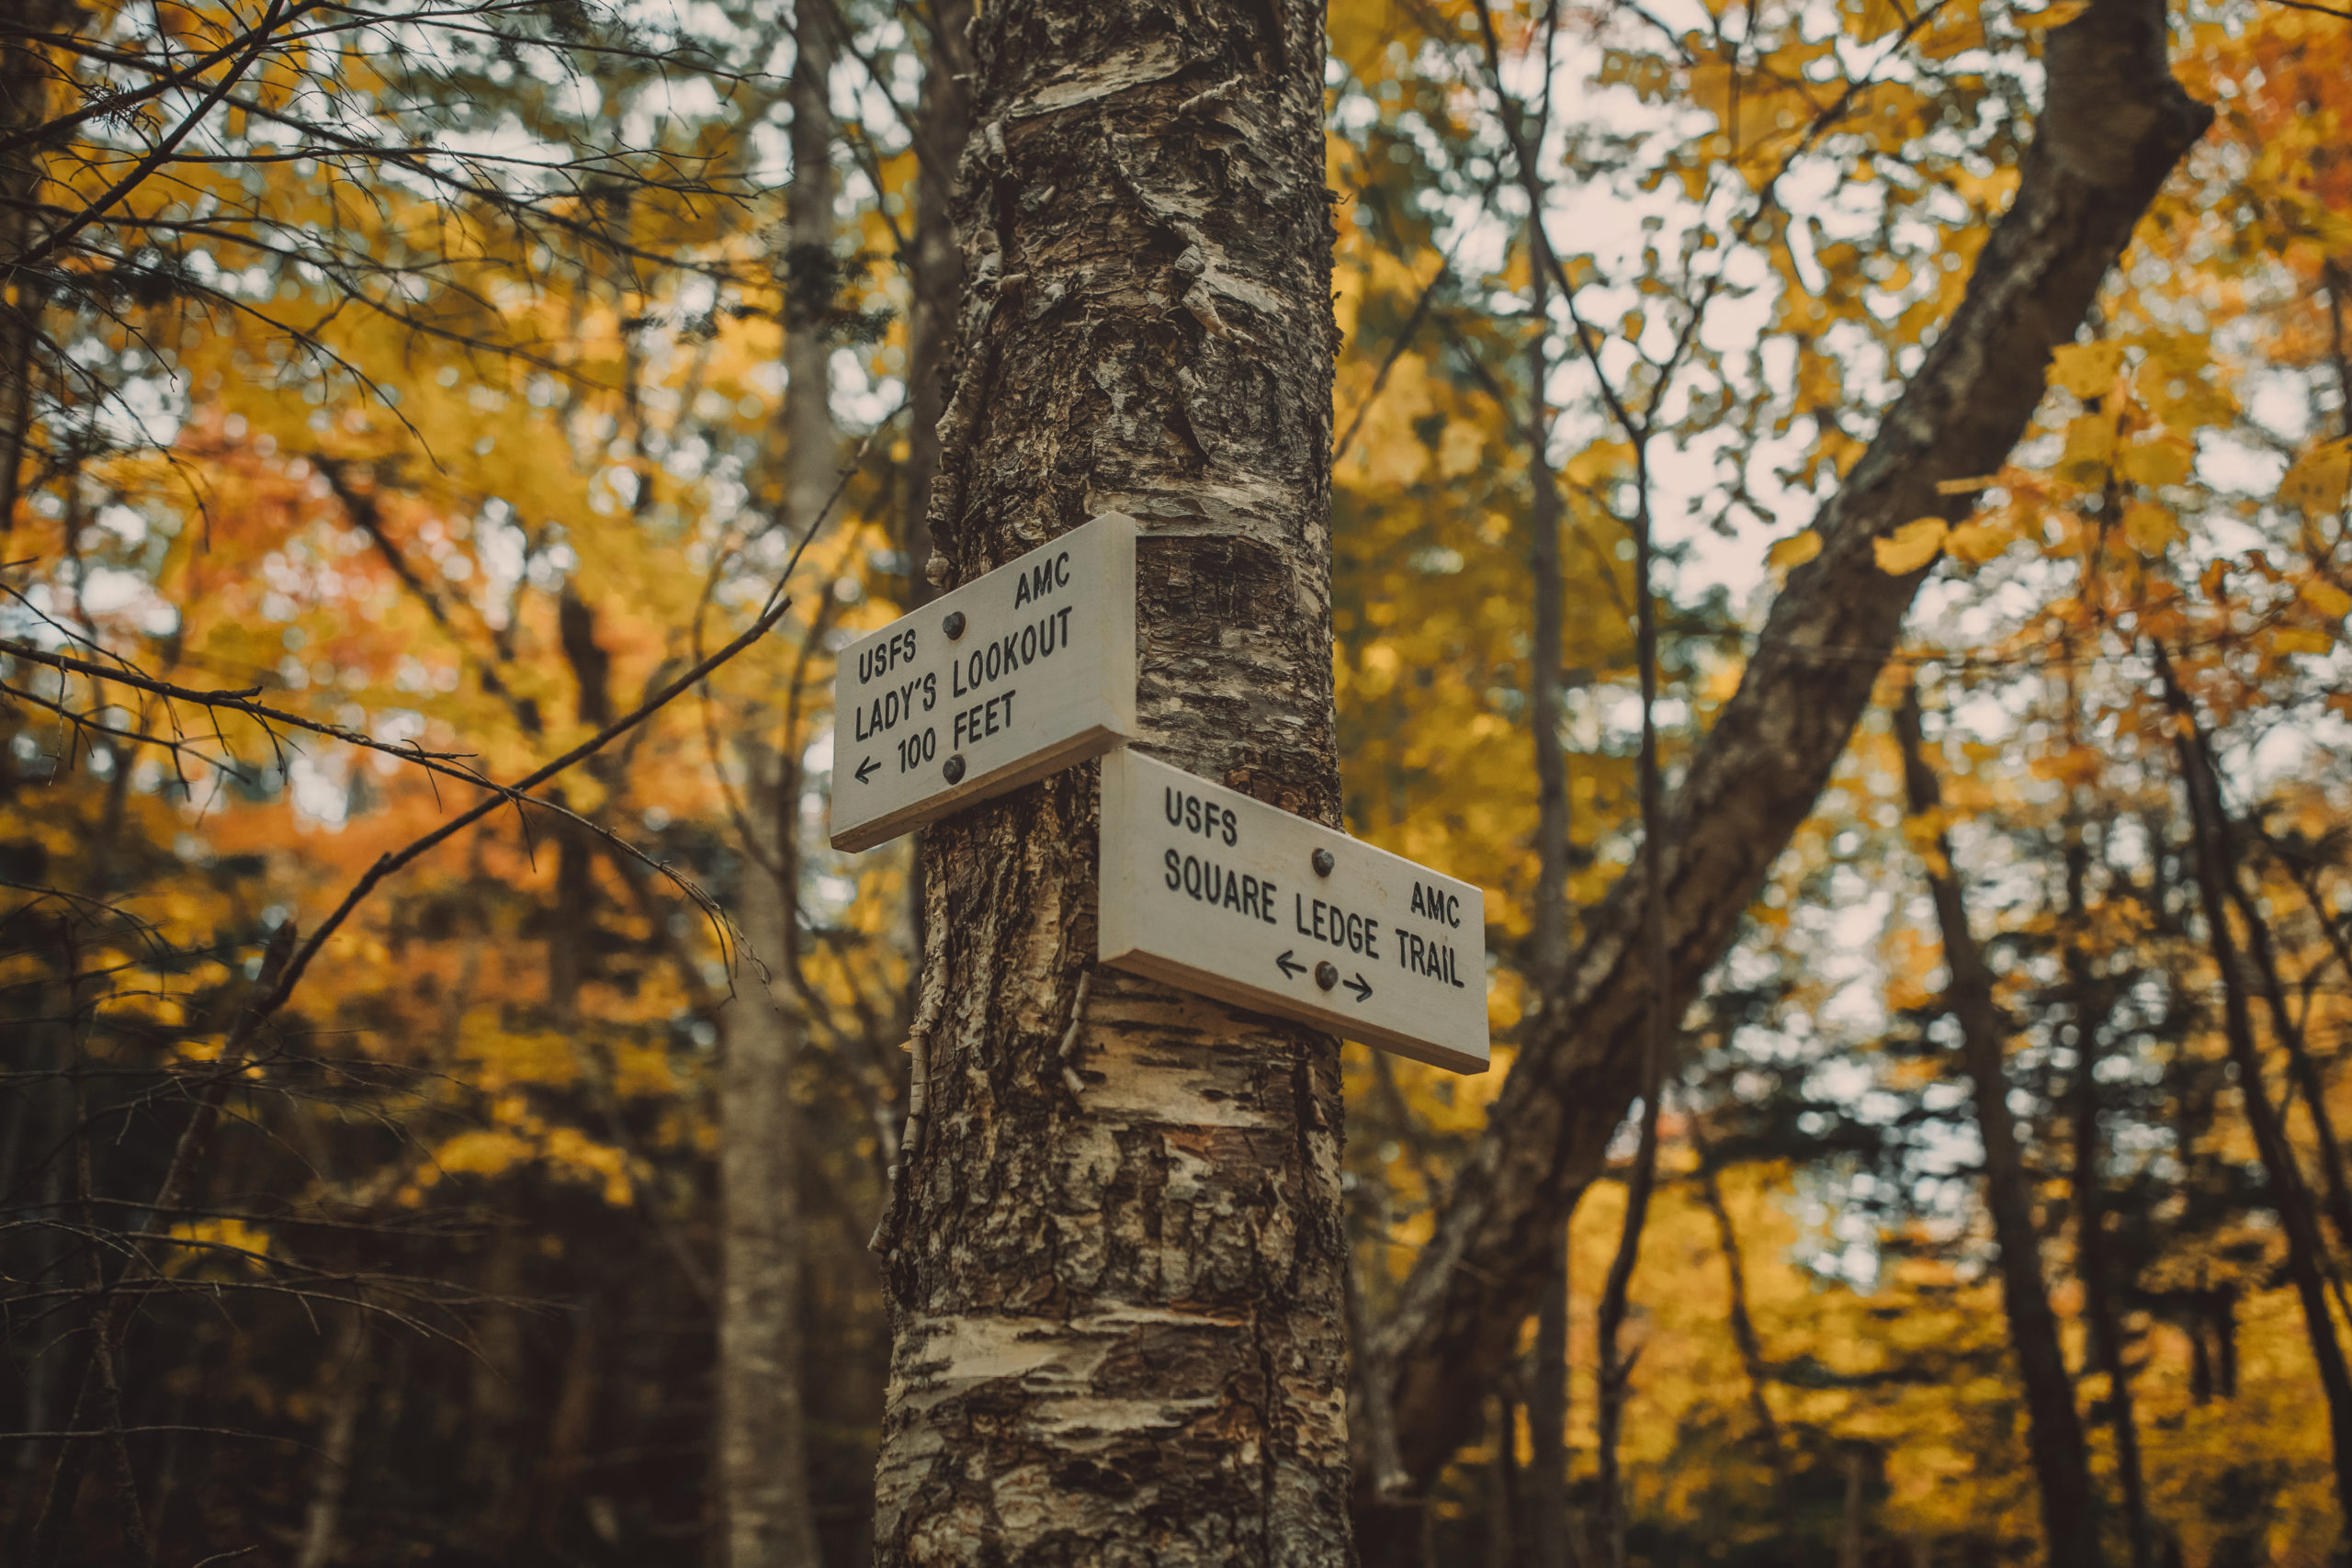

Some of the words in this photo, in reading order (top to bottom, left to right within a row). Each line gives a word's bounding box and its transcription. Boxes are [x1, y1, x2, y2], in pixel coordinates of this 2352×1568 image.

[1014, 551, 1069, 610] AMC
[855, 671, 936, 742] LADY'S
[953, 605, 1072, 698] LOOKOUT
[859, 628, 916, 684] USFS
[898, 727, 936, 773] 100
[954, 690, 1016, 750] FEET
[1165, 785, 1238, 847] USFS
[1165, 848, 1277, 924] SQUARE
[1295, 893, 1379, 959] LEDGE
[1396, 929, 1464, 988] TRAIL
[1410, 881, 1460, 929] AMC
